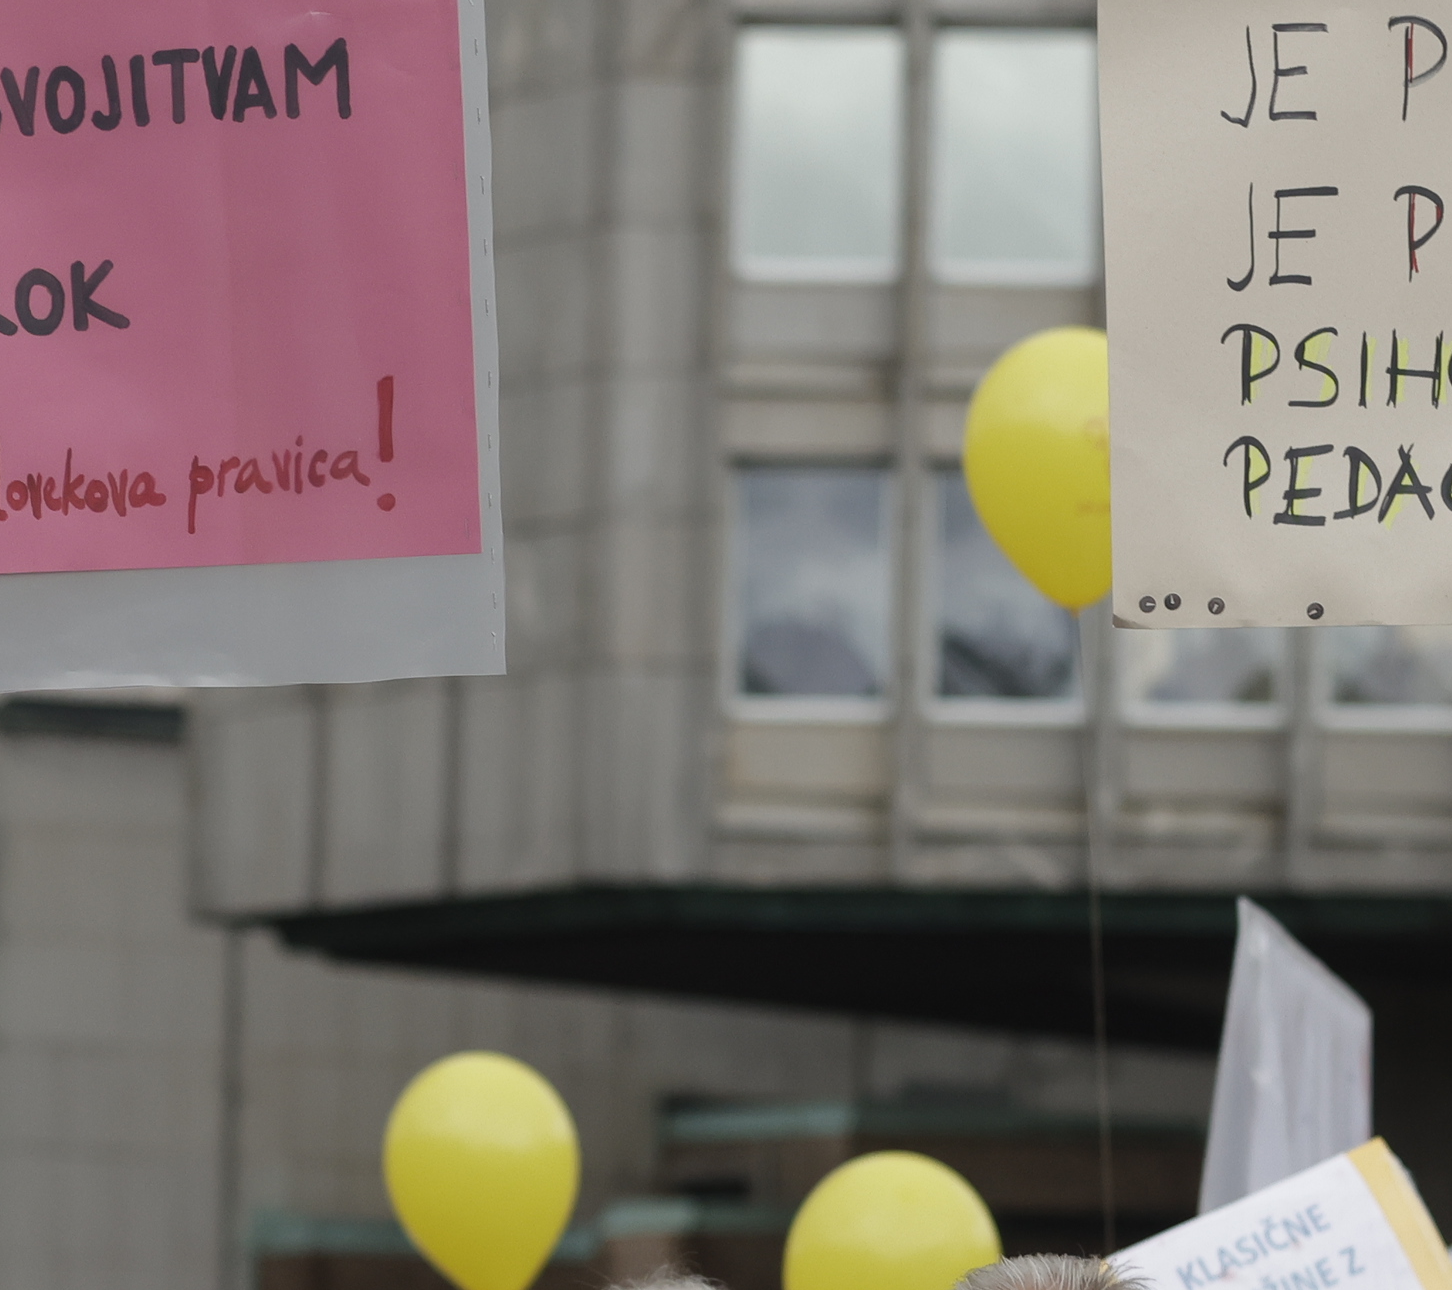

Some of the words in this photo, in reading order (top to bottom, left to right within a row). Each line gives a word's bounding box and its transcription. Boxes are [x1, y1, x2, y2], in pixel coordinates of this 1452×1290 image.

[1221, 20, 1328, 126] JE
[1226, 183, 1339, 292] JE
[1344, 1245, 1366, 1277] Z
